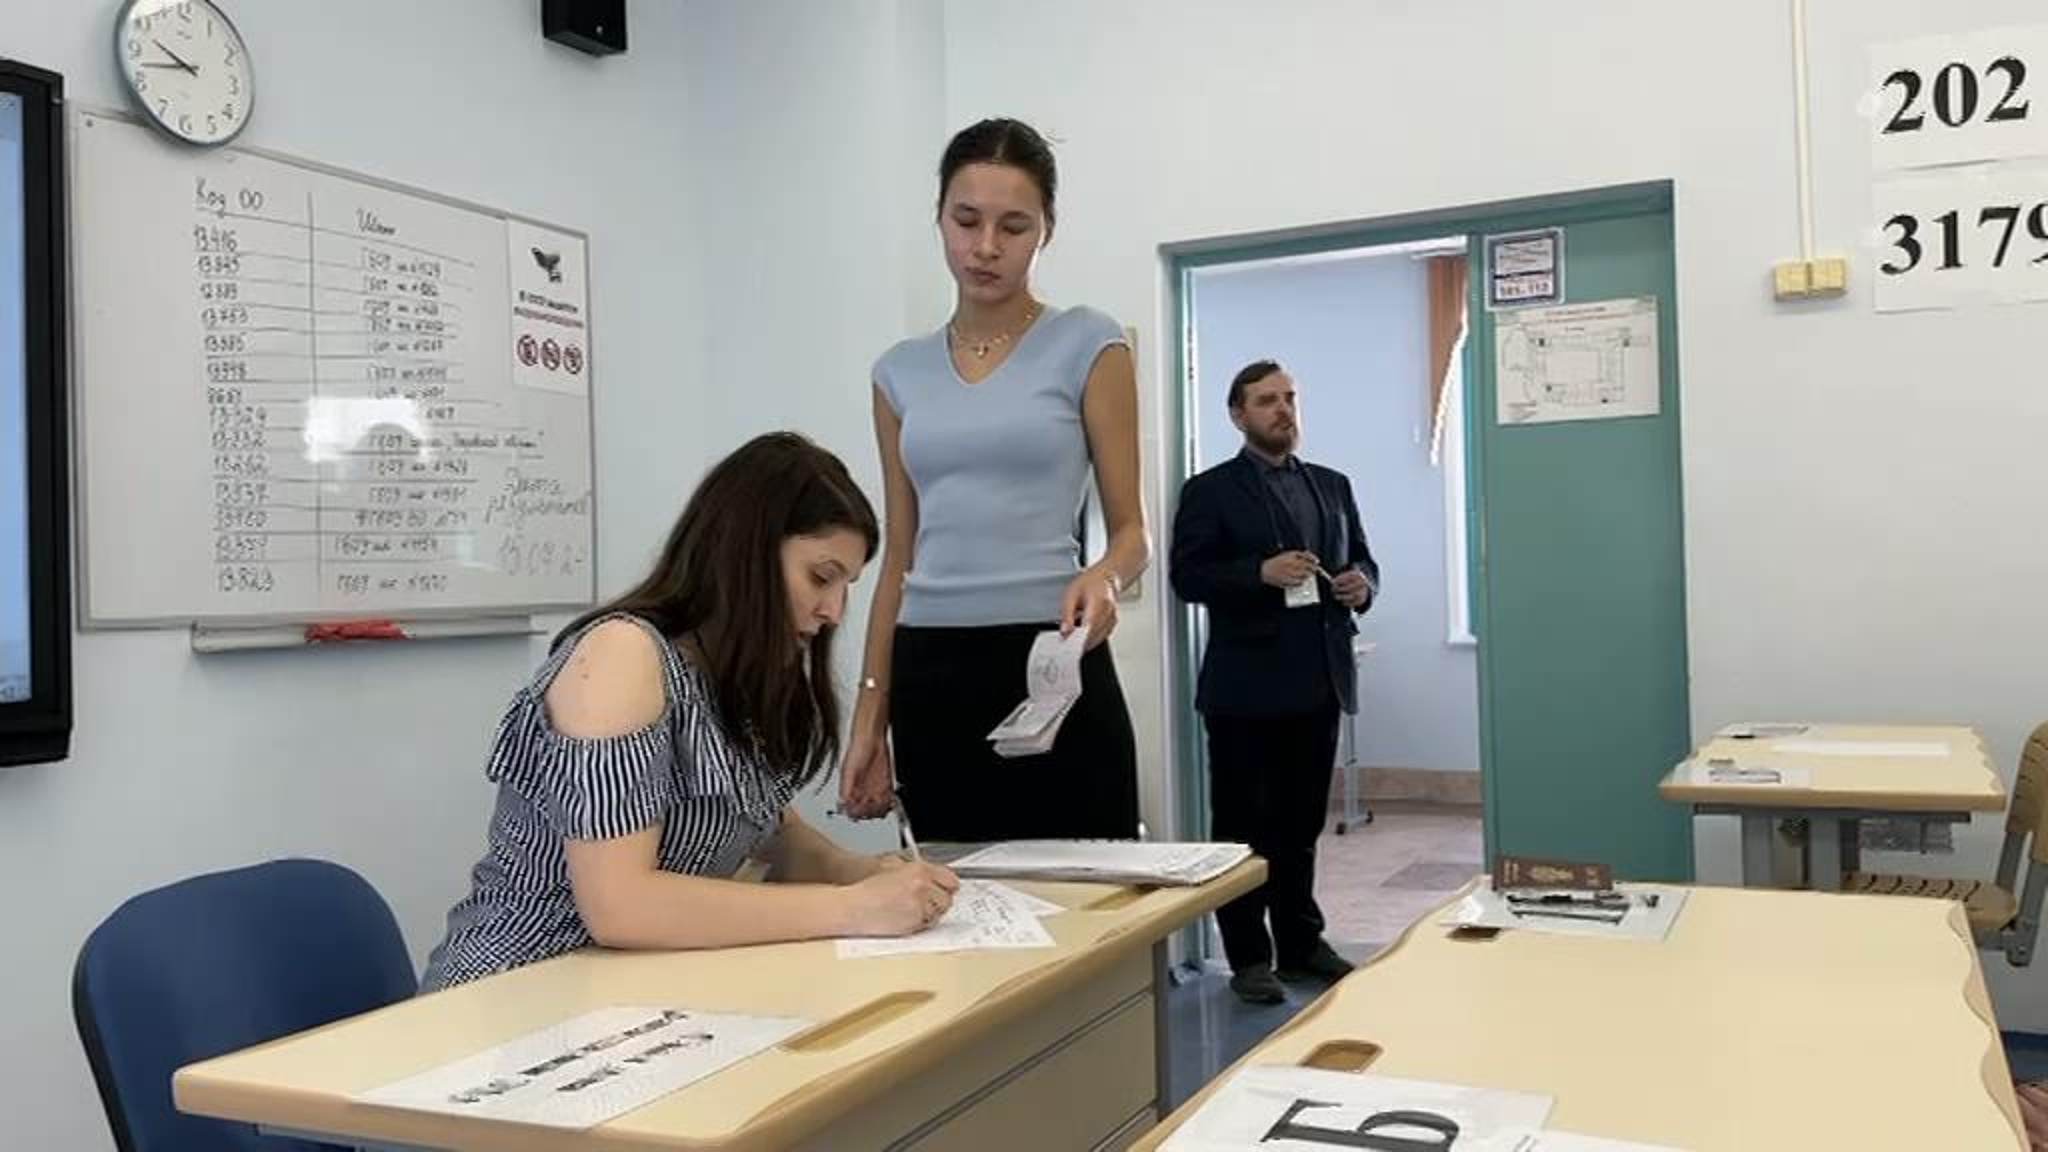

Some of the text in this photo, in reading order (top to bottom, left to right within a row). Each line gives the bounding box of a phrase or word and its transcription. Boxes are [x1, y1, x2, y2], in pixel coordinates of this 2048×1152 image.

[224, 43, 239, 66] 2
[135, 71, 147, 92] 8
[1881, 56, 2030, 134] 202
[178, 114, 193, 134] 6
